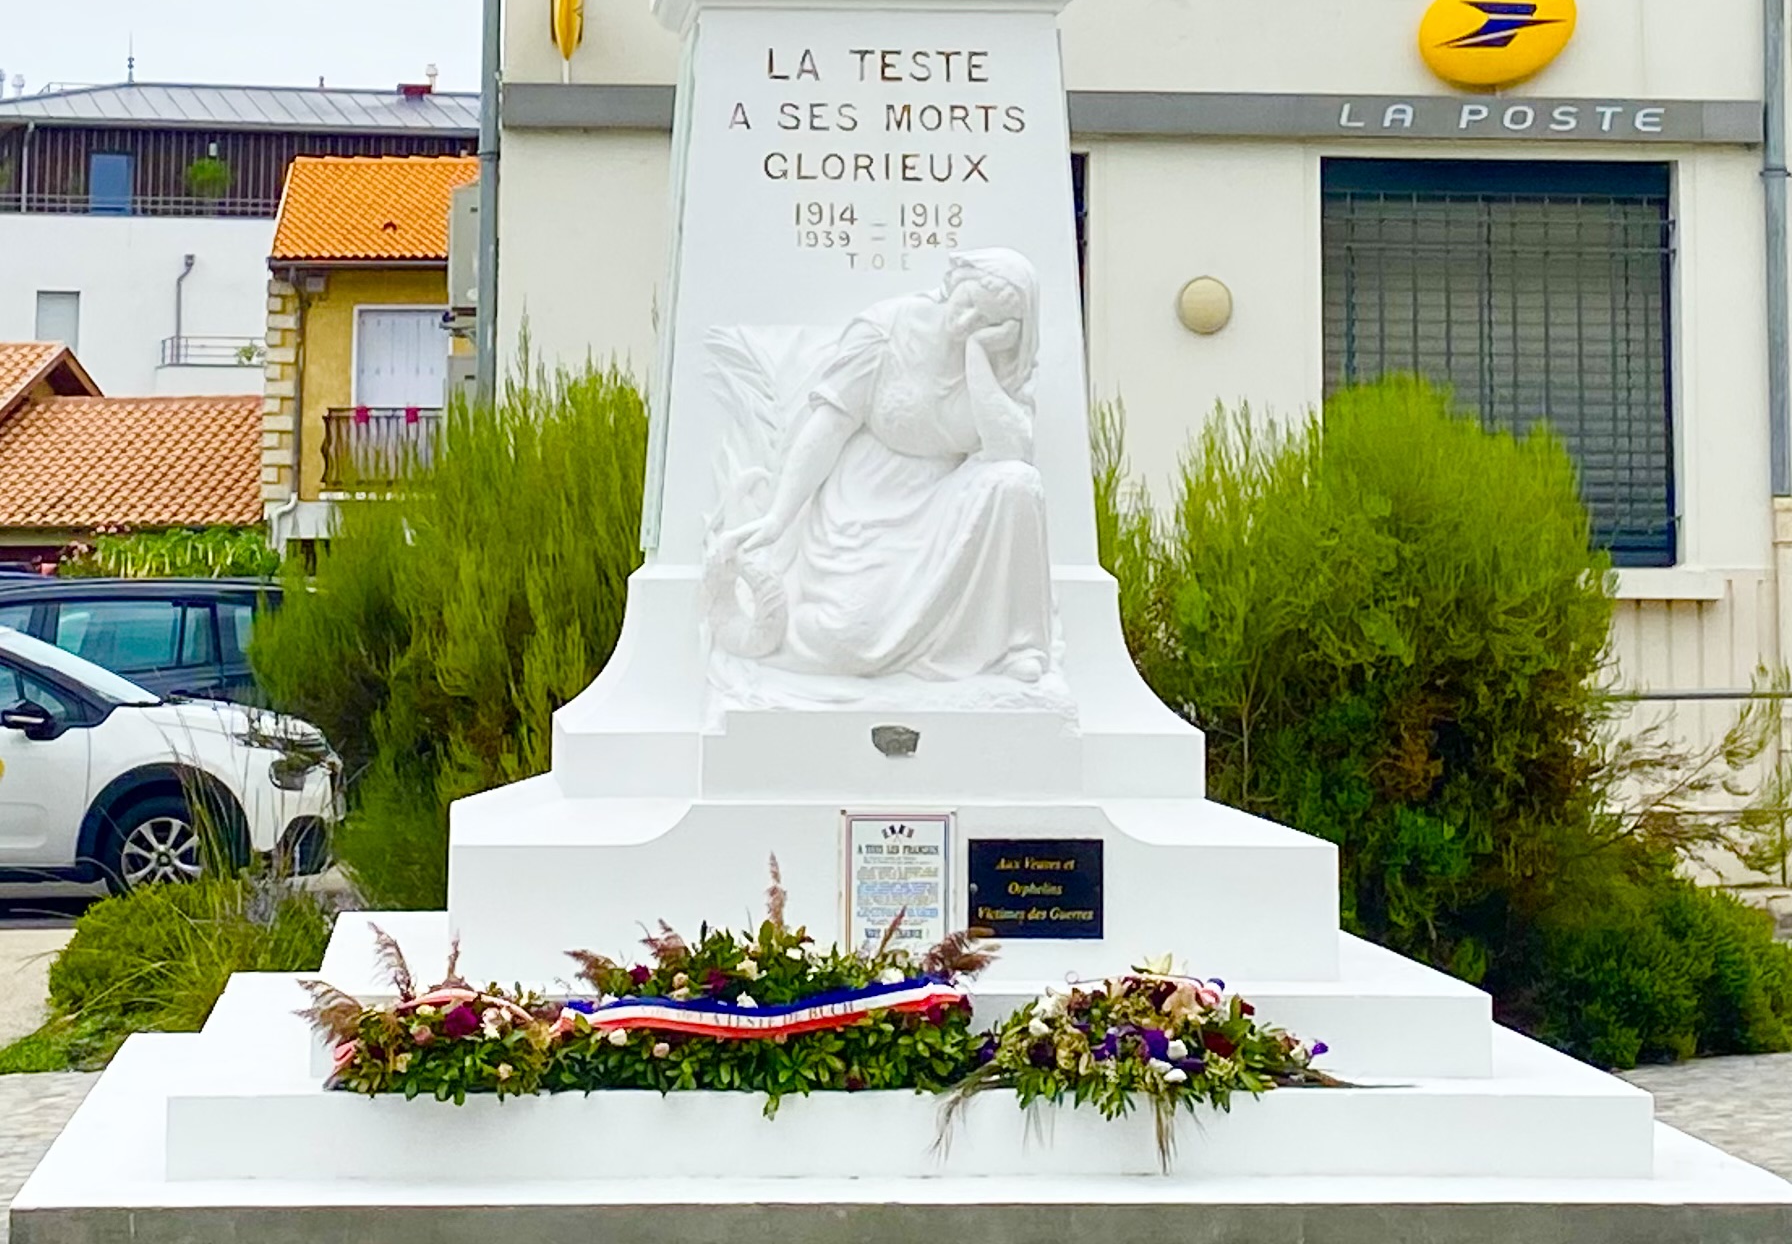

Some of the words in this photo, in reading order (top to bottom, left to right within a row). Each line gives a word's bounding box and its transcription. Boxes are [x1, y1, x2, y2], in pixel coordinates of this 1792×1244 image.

[767, 47, 821, 82] LA
[849, 48, 990, 83] TESTE
[728, 101, 752, 131] A
[776, 102, 859, 132] SES
[884, 103, 1026, 134] MORTS
[1339, 102, 1415, 129] LA
[1458, 103, 1666, 133] POSTE
[763, 152, 990, 183] GLORIEUX
[794, 202, 859, 228] 1914
[900, 202, 964, 229] 1918
[797, 230, 852, 249] 1939
[902, 231, 959, 250] 1945
